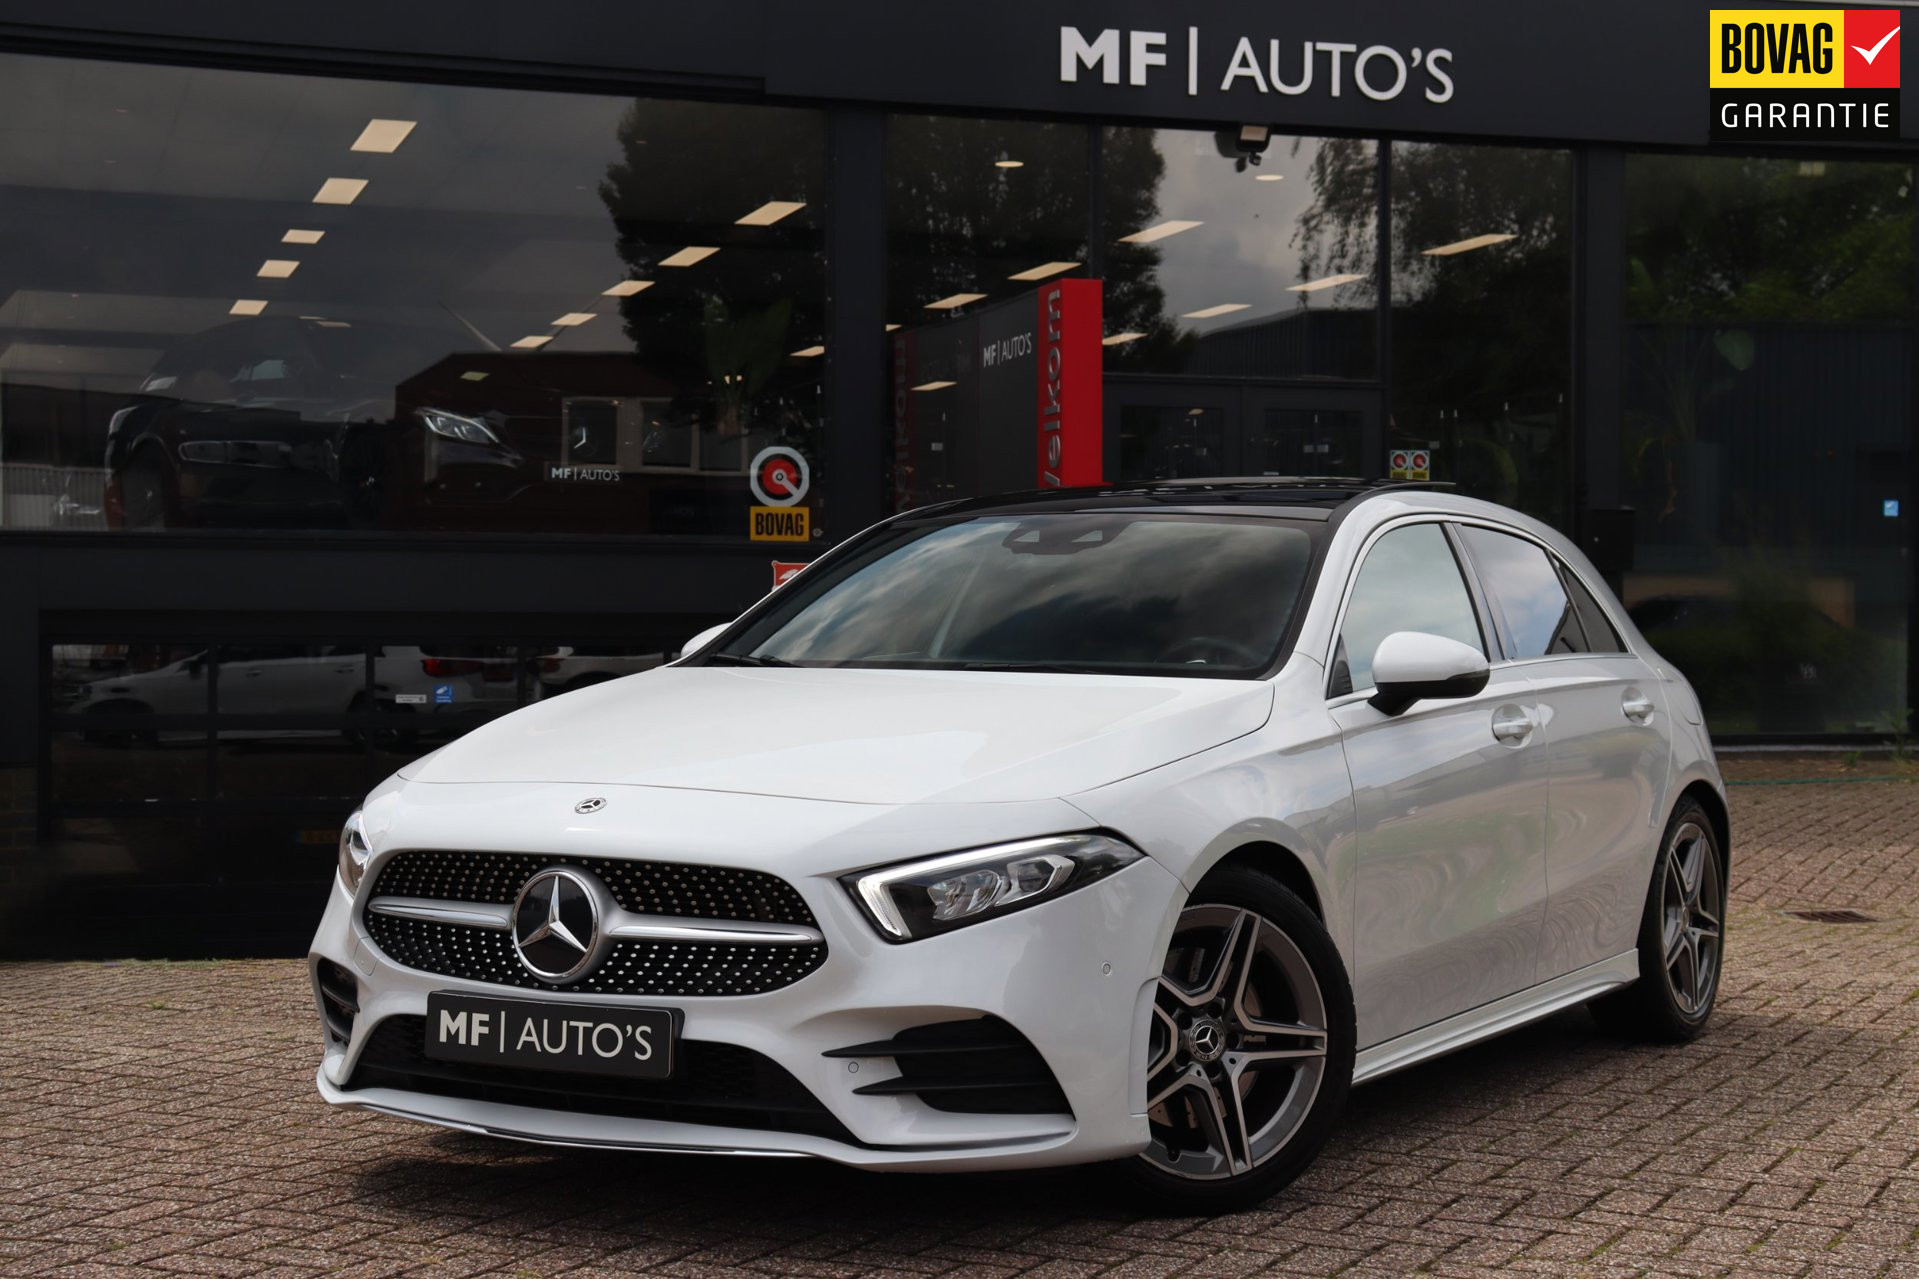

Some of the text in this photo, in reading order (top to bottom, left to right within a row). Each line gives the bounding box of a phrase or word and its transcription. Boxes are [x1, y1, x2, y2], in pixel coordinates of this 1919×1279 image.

[1060, 26, 1454, 104] MF AUTO'S
[983, 344, 997, 368] MF
[1001, 331, 1032, 362] AUTO'S
[1043, 289, 1061, 487] elkom
[551, 467, 620, 481] MF AUTO'S
[754, 512, 805, 537] BOVAG
[439, 1009, 652, 1061] MF AUTO'S
